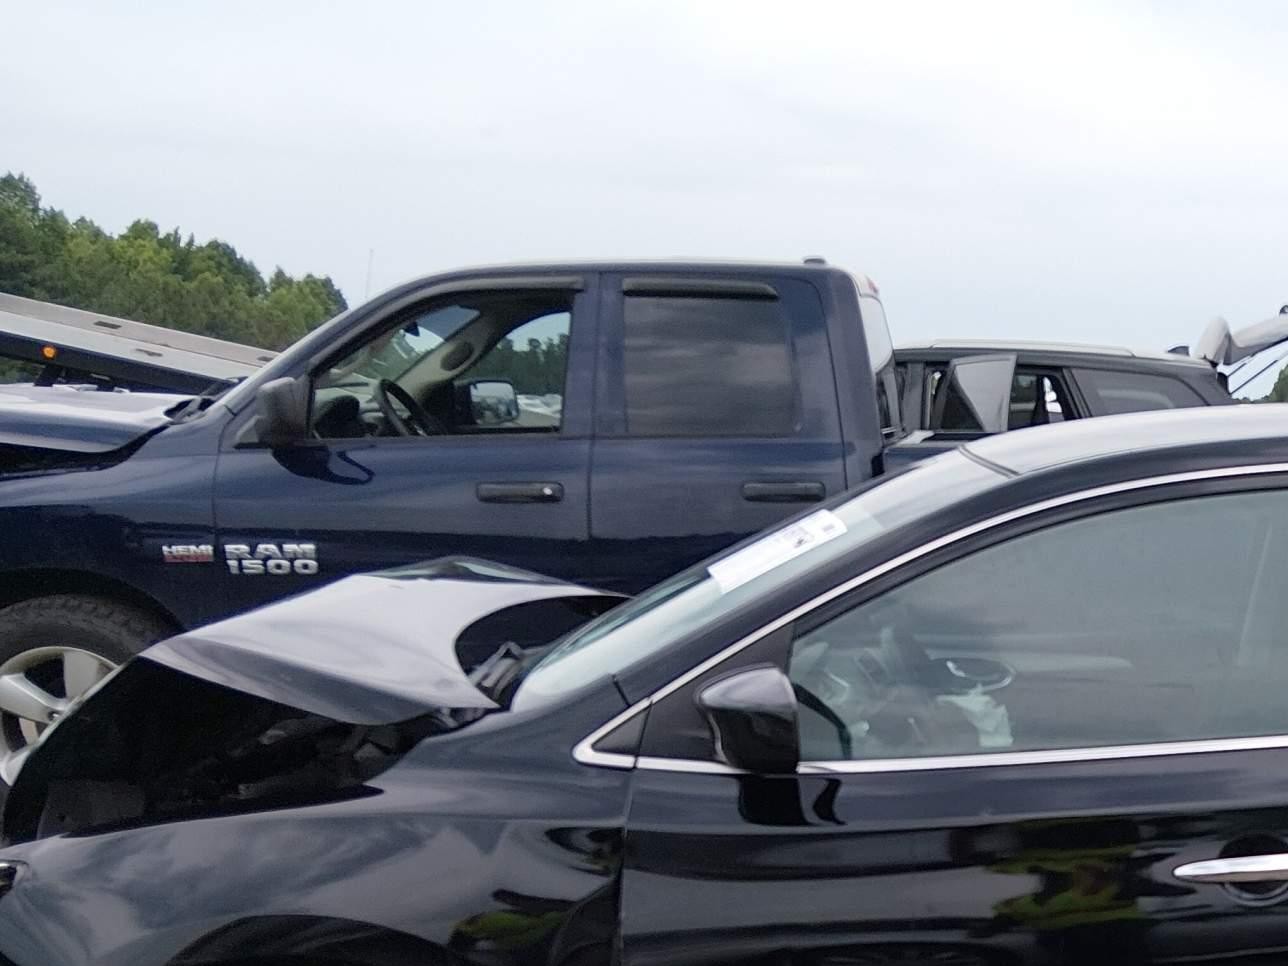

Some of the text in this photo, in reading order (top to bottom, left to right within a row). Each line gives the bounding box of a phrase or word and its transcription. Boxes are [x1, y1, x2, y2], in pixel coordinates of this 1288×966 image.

[161, 544, 214, 556] HEMI
[224, 543, 316, 559] RAM
[226, 559, 319, 575] 1500
